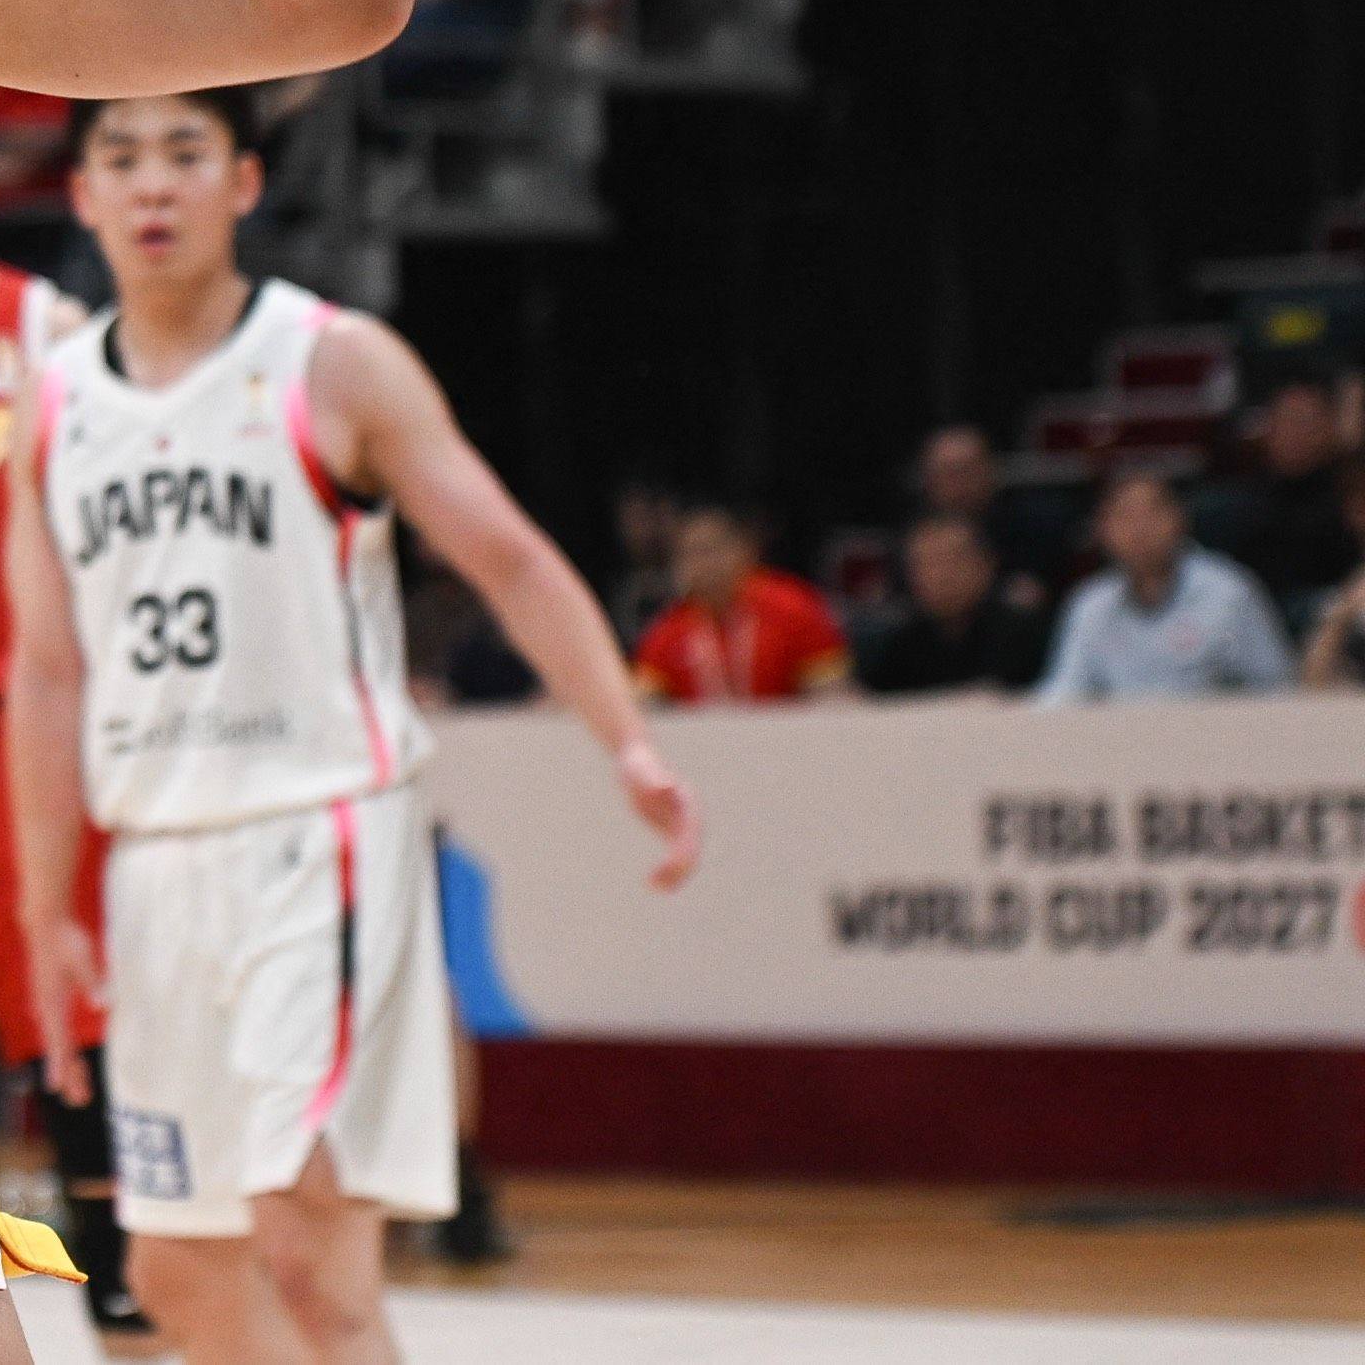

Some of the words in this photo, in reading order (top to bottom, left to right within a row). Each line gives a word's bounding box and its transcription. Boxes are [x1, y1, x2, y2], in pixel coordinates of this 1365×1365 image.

[77, 466, 274, 567] JAPAN
[130, 587, 219, 672] 33
[985, 793, 1115, 863] FIBA
[833, 880, 1028, 952] WORLD
[1046, 880, 1167, 952] CUP
[1187, 877, 1339, 952] 2027
